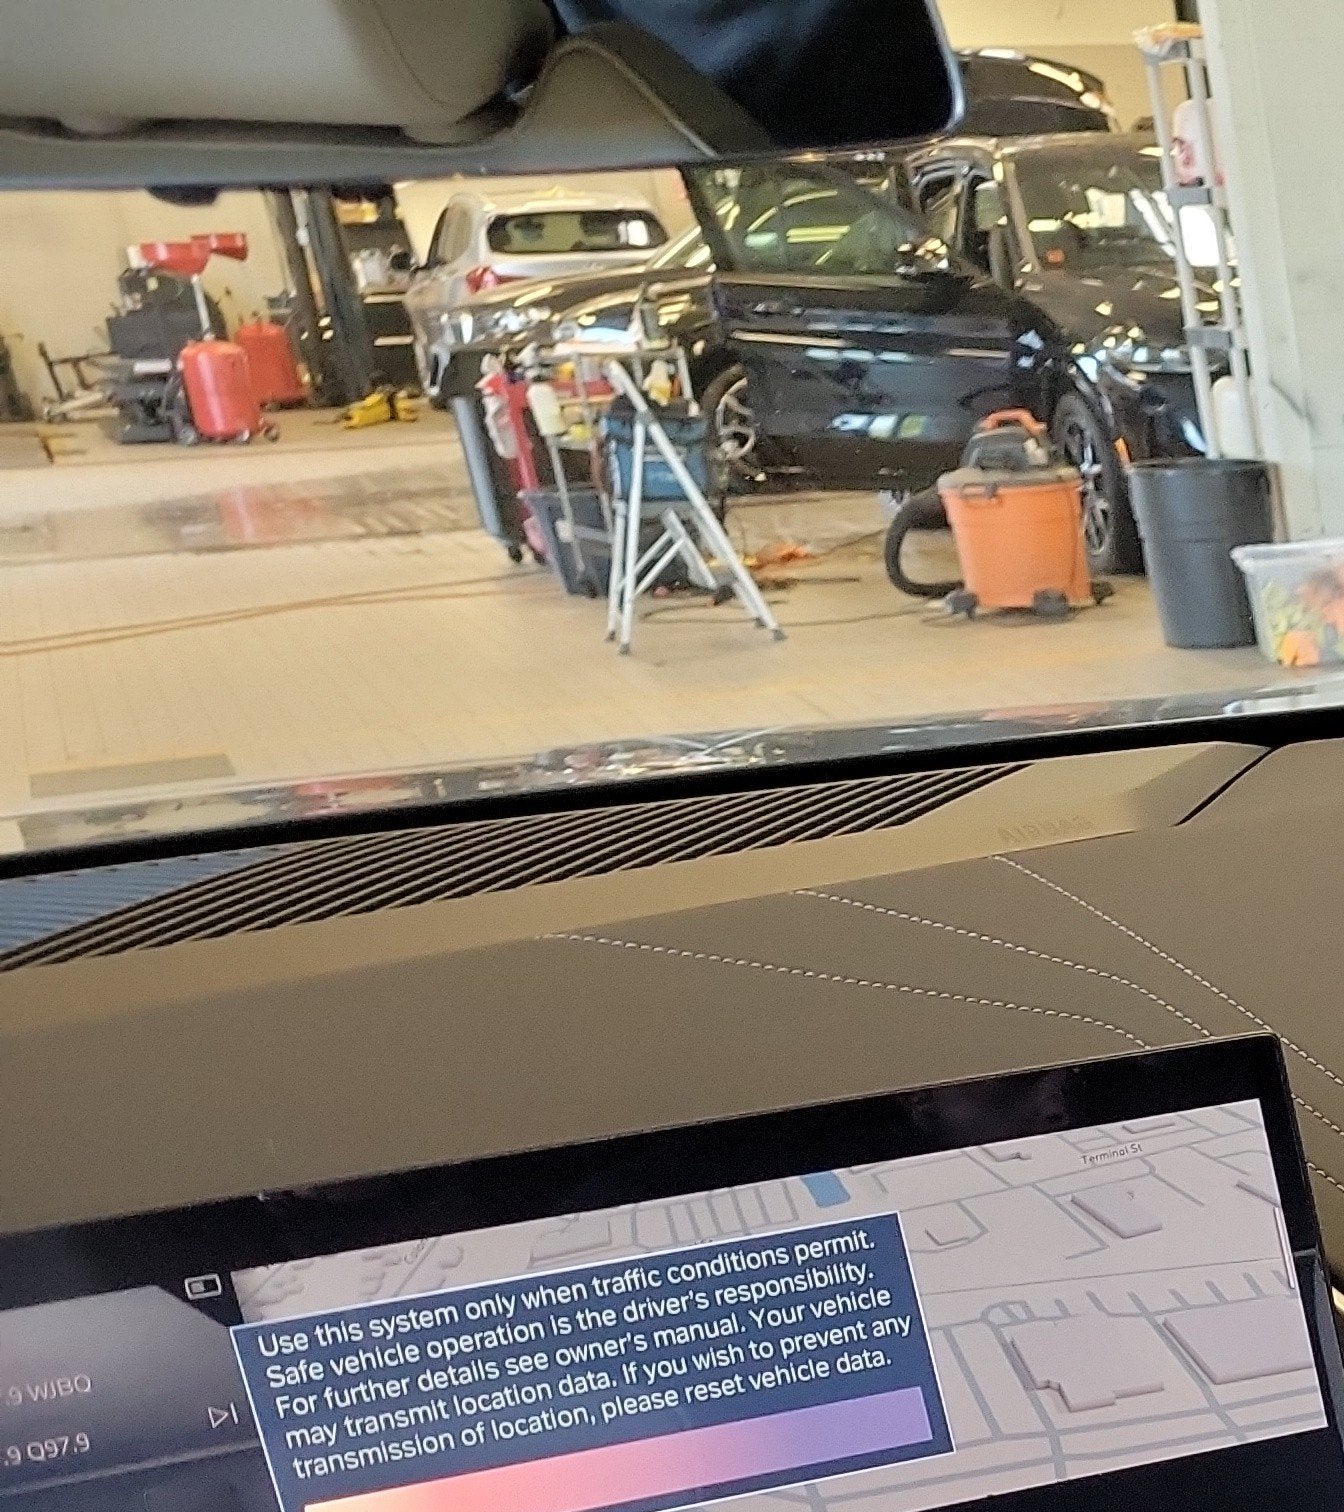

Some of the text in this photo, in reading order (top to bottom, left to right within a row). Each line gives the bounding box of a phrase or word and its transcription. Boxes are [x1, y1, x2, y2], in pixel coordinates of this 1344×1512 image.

[1081, 1143, 1143, 1164] Terminal St
[258, 1230, 874, 1356] Use this system only when traffic conditions permit.
[267, 1262, 873, 1388] Safe vehicle operation is the driver's responsibility.
[276, 1288, 891, 1419] For further details see owner's manual. Your vehicle
[286, 1316, 910, 1449] may transmit location data. If you wish to prevent any
[293, 1347, 891, 1479] transmission of location, please reset vehicle data.
